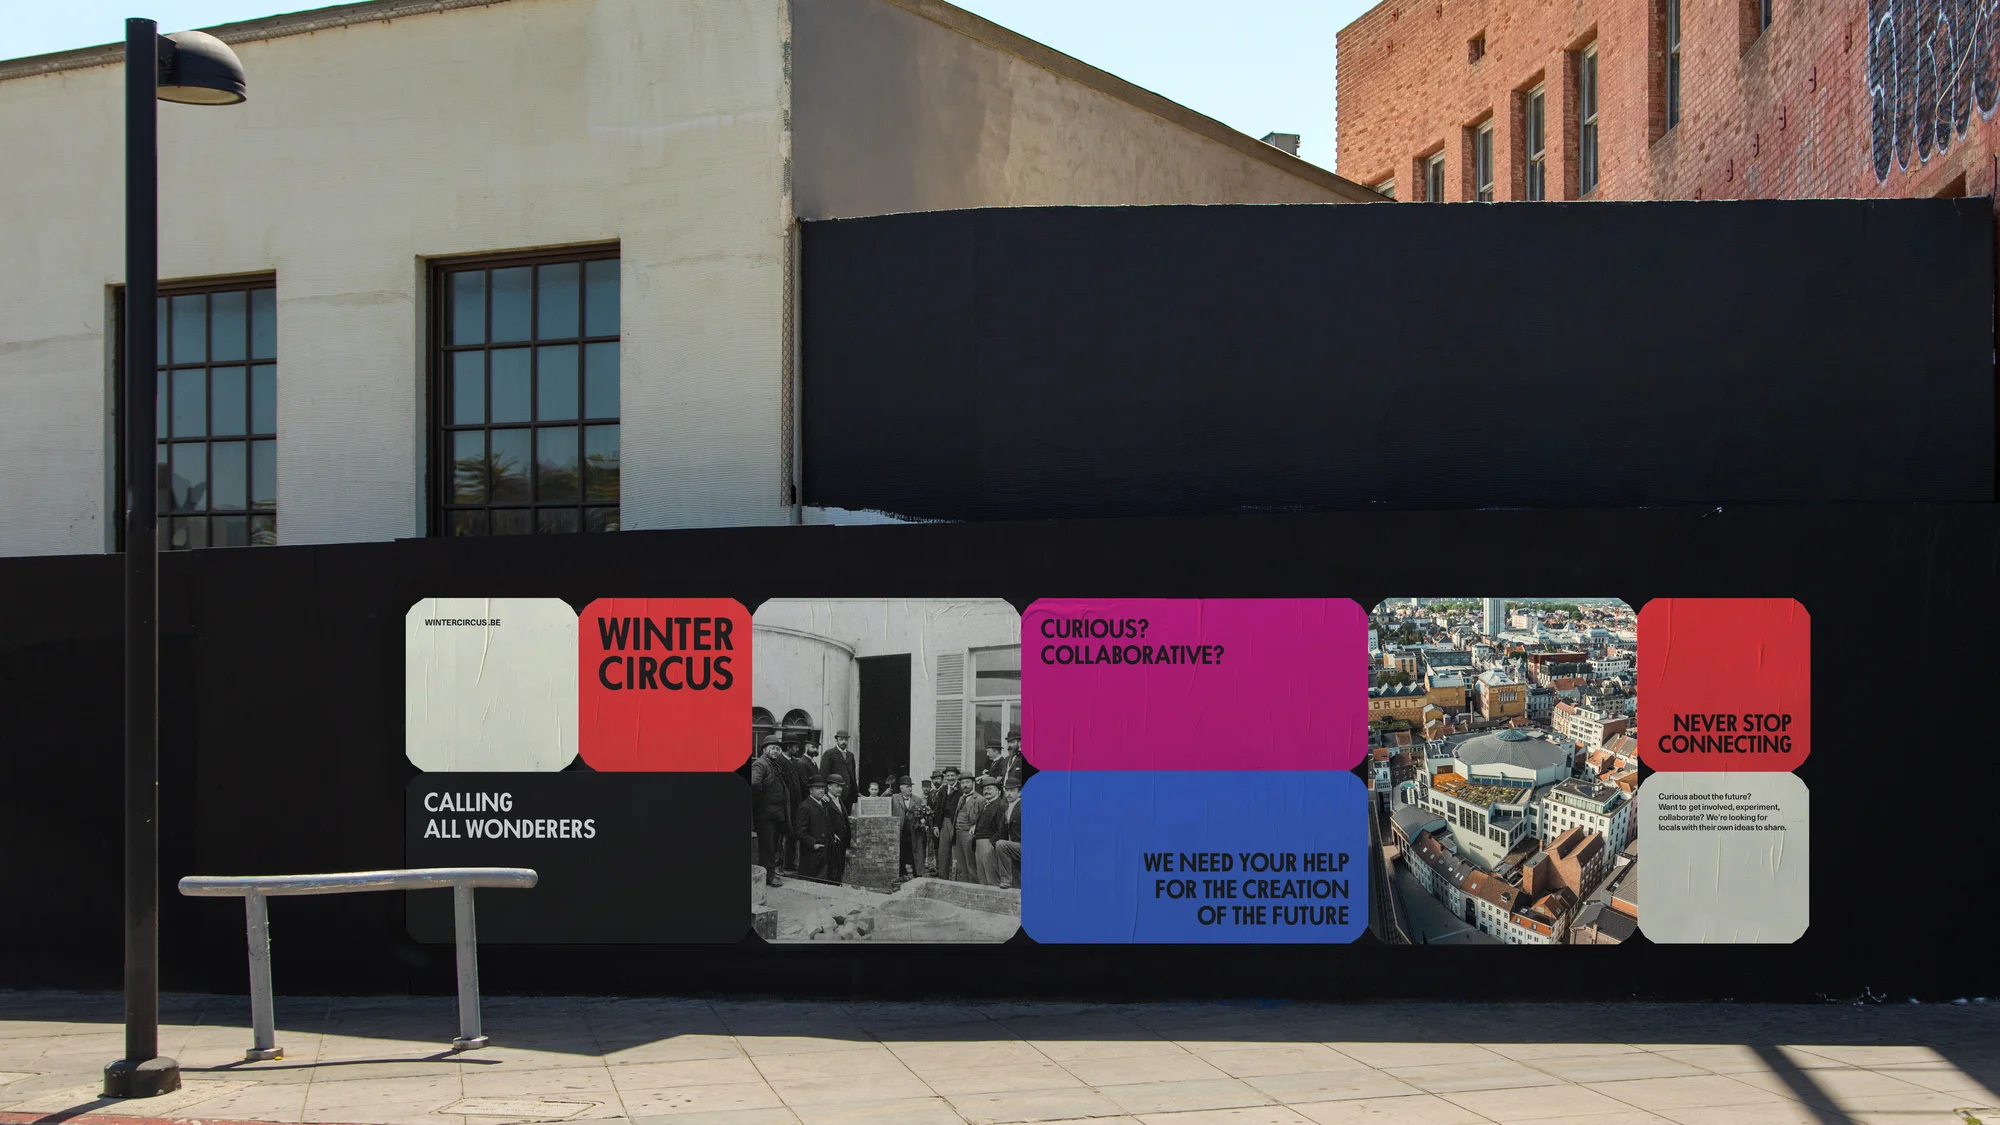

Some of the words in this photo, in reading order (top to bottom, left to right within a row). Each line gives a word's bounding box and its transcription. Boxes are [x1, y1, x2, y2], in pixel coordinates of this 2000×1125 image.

[424, 618, 501, 627] WINTERCIRCUS.BE
[1040, 618, 1149, 639] CURIOUS?
[598, 617, 734, 651] WINTER
[1040, 645, 1225, 665] COLLABORATIVE?
[598, 655, 734, 691] CIRCUS
[1673, 714, 1738, 732] NEVER
[1743, 713, 1792, 732] STOP
[1658, 735, 1792, 753] CONNECTING
[424, 792, 513, 812] CALLING
[1658, 792, 1688, 801] Curious
[1689, 792, 1711, 801] about
[1711, 793, 1724, 801] the
[1724, 792, 1752, 801] future?
[1658, 803, 1678, 811] Want
[1688, 804, 1701, 812] get
[1702, 803, 1735, 812] involved,
[1736, 803, 1781, 812] experiment,
[1658, 813, 1705, 821] collaborate?
[1706, 813, 1728, 821] We're
[1729, 813, 1756, 822] looking
[1757, 813, 1768, 821] for
[1658, 823, 1681, 831] locals
[1681, 823, 1698, 831] with
[1699, 823, 1716, 831] their
[1734, 823, 1755, 831] ideas
[1764, 823, 1787, 831] share.
[424, 819, 461, 839] ALL
[466, 818, 596, 839] WONDERERS
[1143, 853, 1174, 872] WE
[1180, 853, 1234, 872] NEED
[1239, 853, 1297, 872] YOUR
[1303, 853, 1350, 872] HELP
[1155, 879, 1197, 899] FOR
[1203, 880, 1237, 899] THE
[1243, 879, 1349, 899] CREATION
[1197, 905, 1227, 925] OF
[1232, 906, 1267, 925] THE
[1273, 905, 1349, 925] FUTURE
